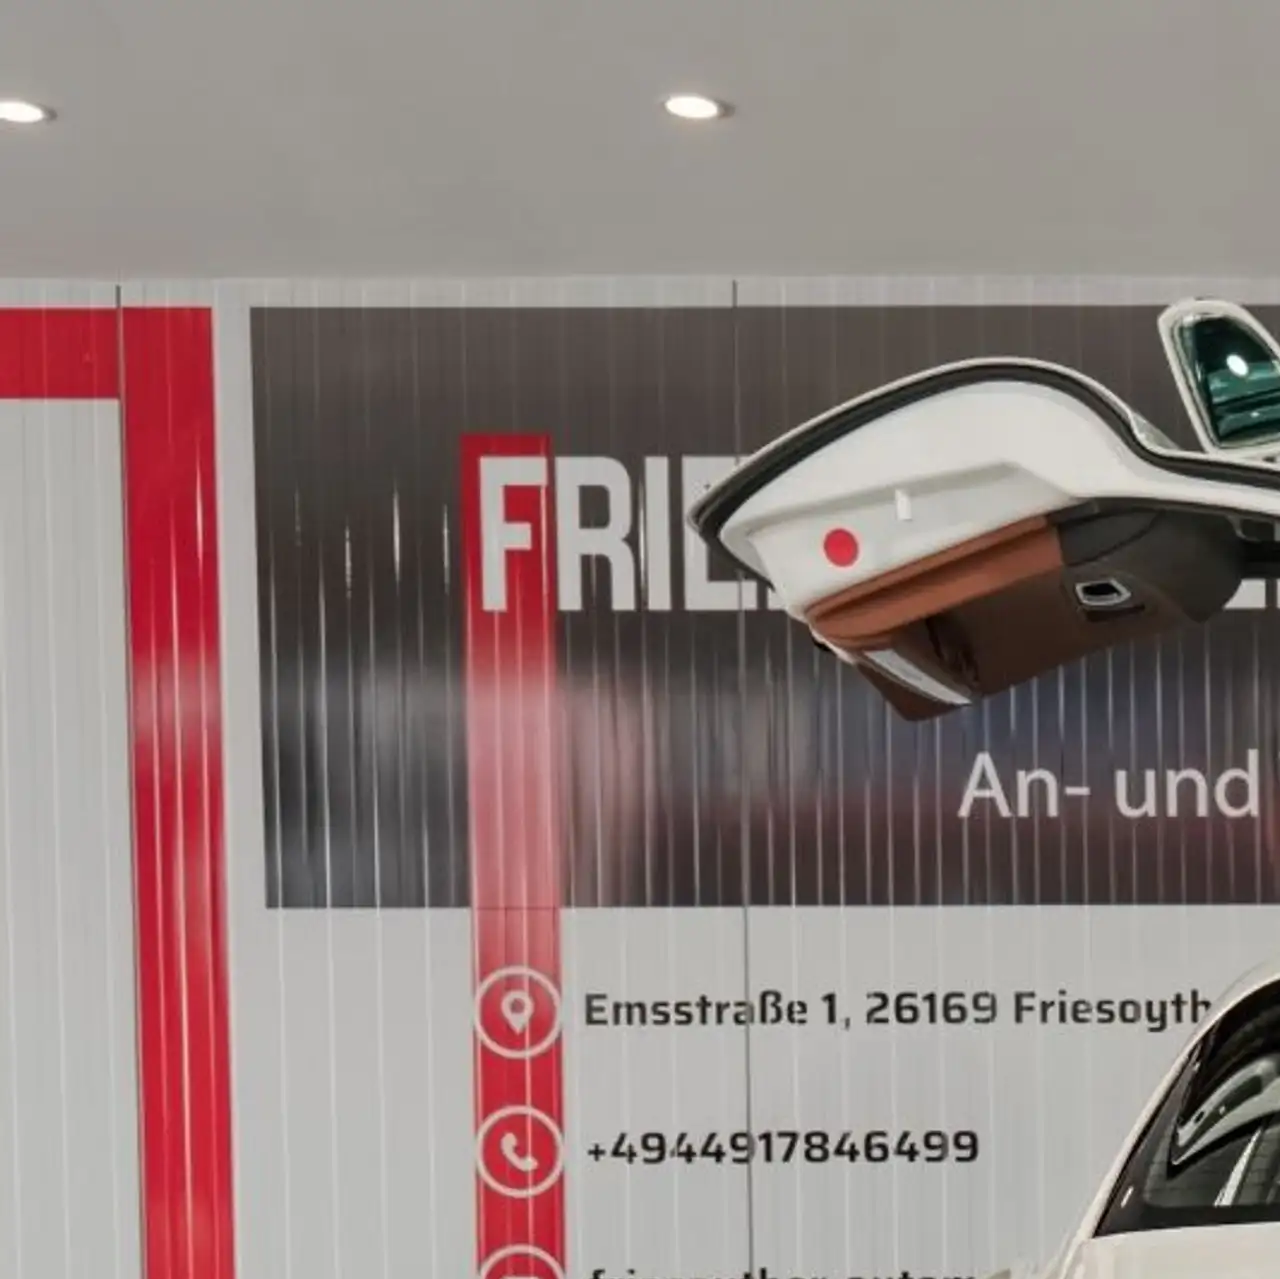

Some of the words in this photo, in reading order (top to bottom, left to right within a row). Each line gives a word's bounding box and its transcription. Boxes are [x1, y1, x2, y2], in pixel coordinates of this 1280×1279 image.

[958, 752, 1091, 819] An-
[1115, 750, 1260, 819] und
[585, 989, 809, 1027] Emsstraße
[821, 992, 851, 1030] 1,
[866, 991, 998, 1025] 26169
[1014, 988, 1212, 1033] Friesoyth
[587, 1130, 979, 1165] +4944917846499
